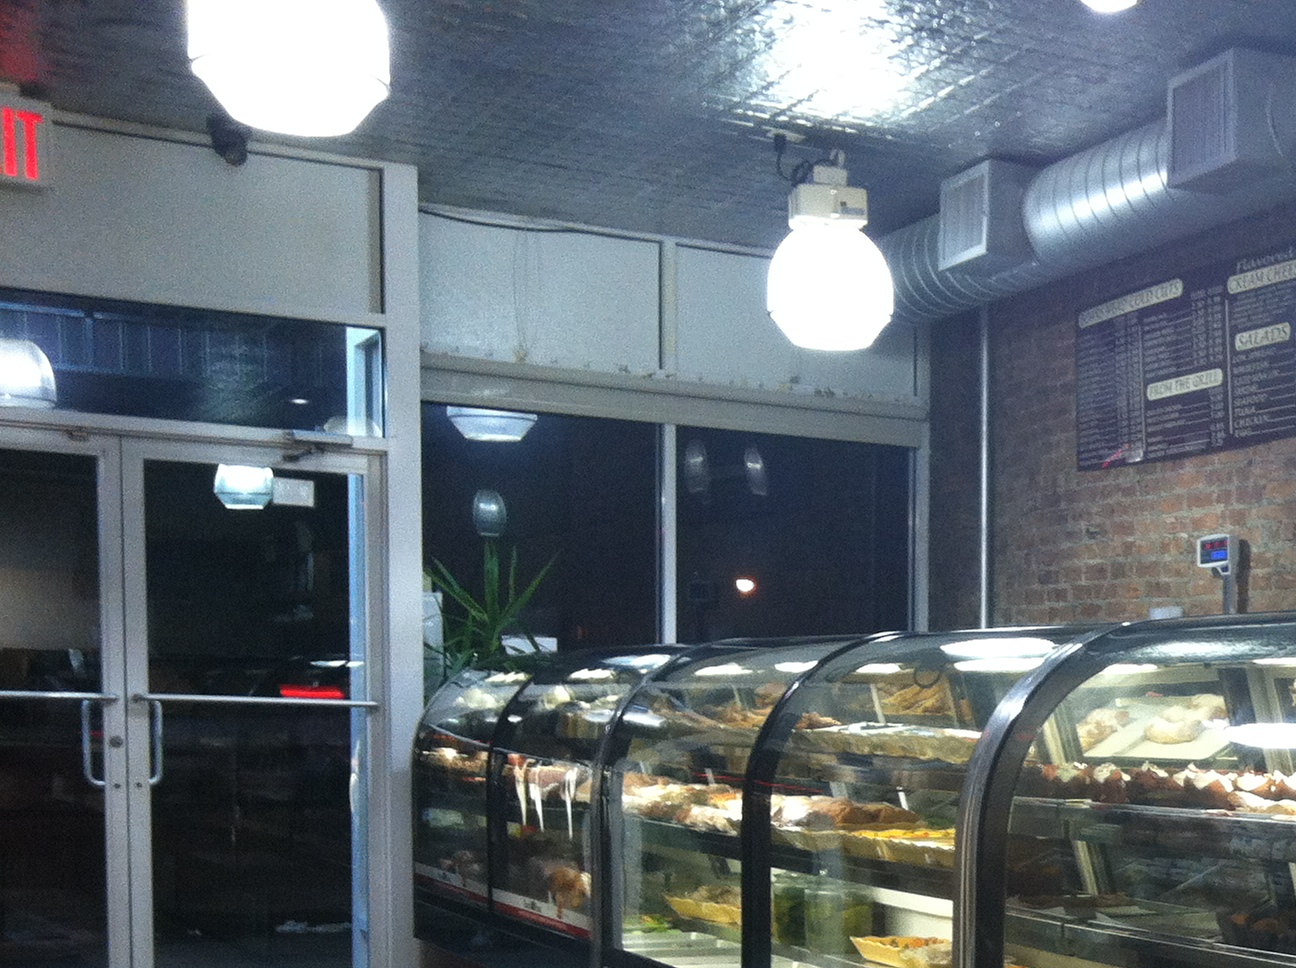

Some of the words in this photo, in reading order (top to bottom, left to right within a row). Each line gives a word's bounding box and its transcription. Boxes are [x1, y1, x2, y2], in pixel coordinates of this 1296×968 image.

[0, 106, 44, 180] IT
[1238, 325, 1289, 348] SALADS
[1192, 369, 1219, 389] GRILL
